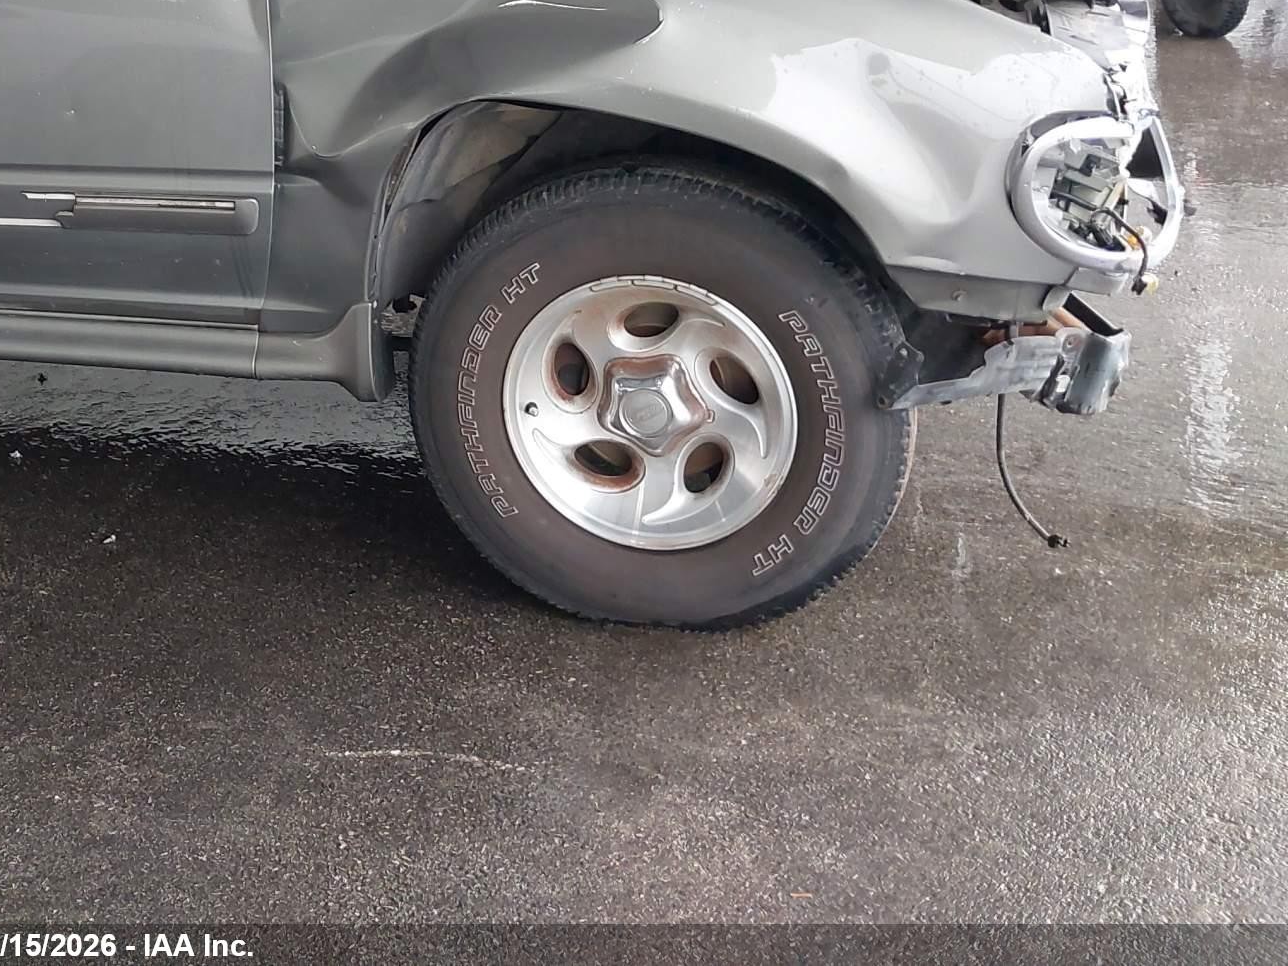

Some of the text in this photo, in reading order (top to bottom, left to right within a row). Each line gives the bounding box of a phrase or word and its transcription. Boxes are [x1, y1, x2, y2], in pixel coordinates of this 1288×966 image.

[458, 262, 541, 518] PATHFINDER HT
[752, 310, 845, 576] PATHFINDER HT
